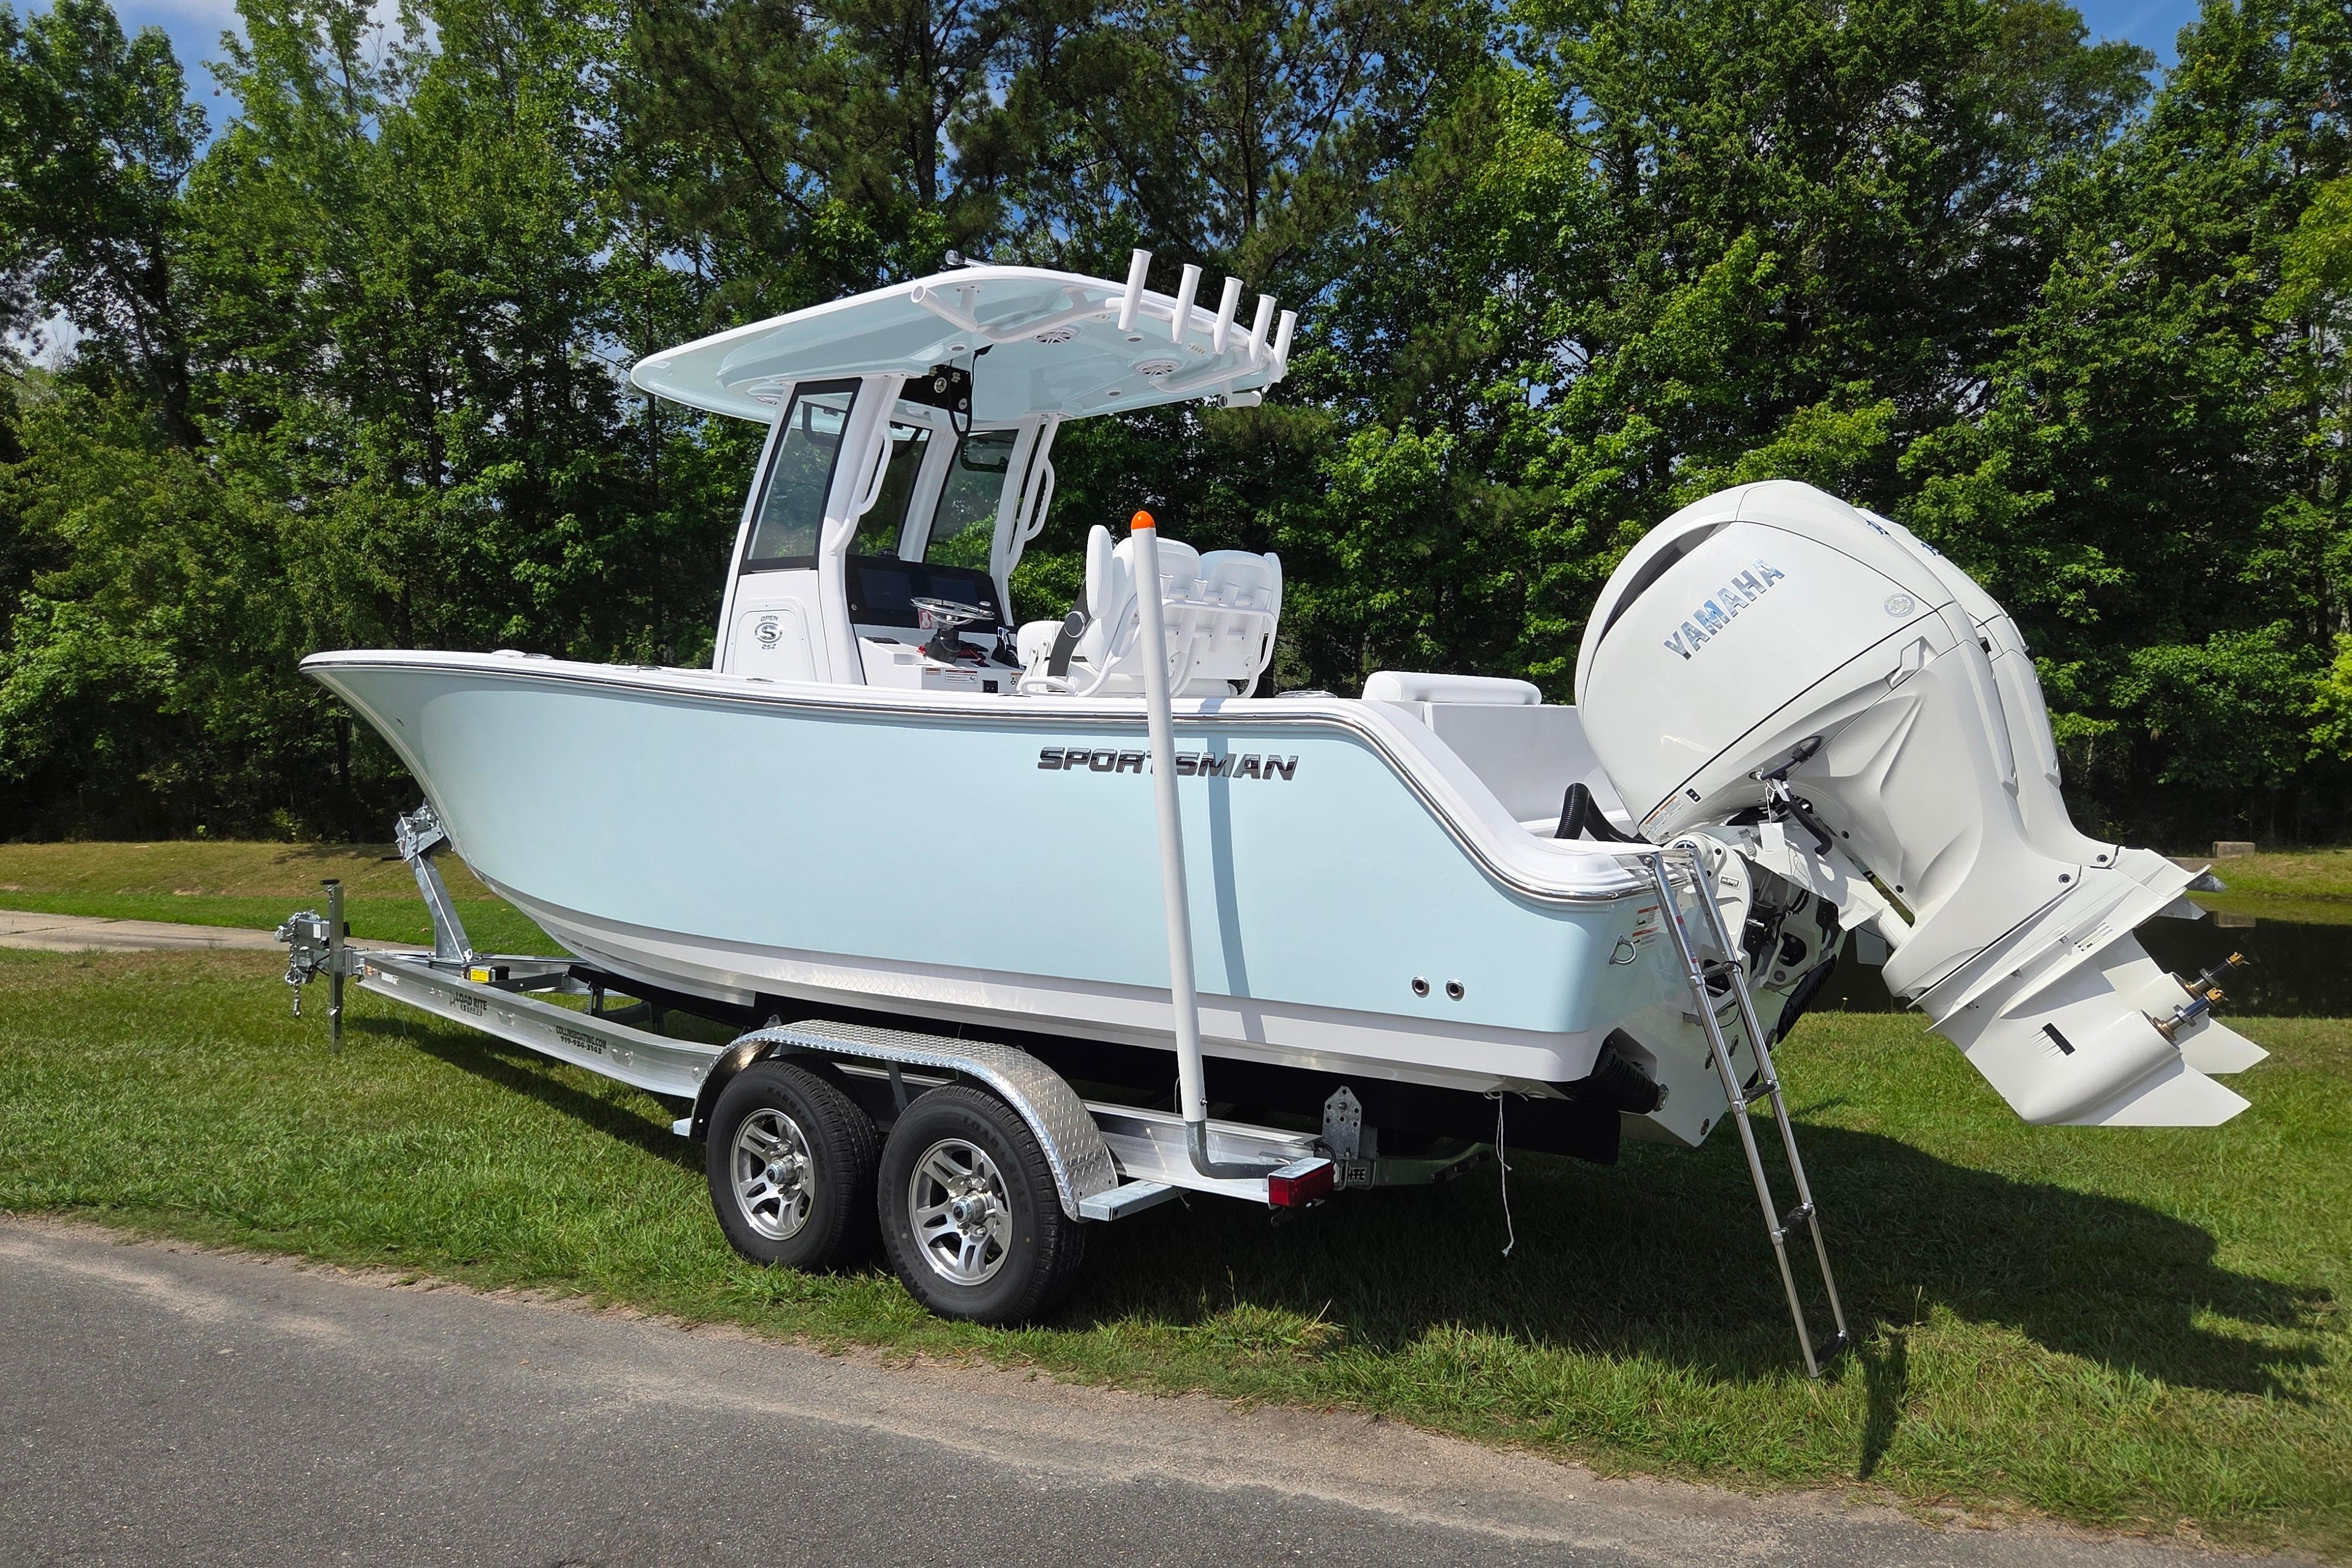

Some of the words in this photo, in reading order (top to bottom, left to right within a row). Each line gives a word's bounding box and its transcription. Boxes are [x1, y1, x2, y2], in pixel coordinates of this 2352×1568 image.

[1663, 559, 1785, 661] YAMAHA
[1037, 747, 1298, 781] SPORSMAN
[456, 991, 472, 1006] LOAD
[473, 997, 487, 1011] RITE
[560, 1035, 602, 1054] 919-934-3143
